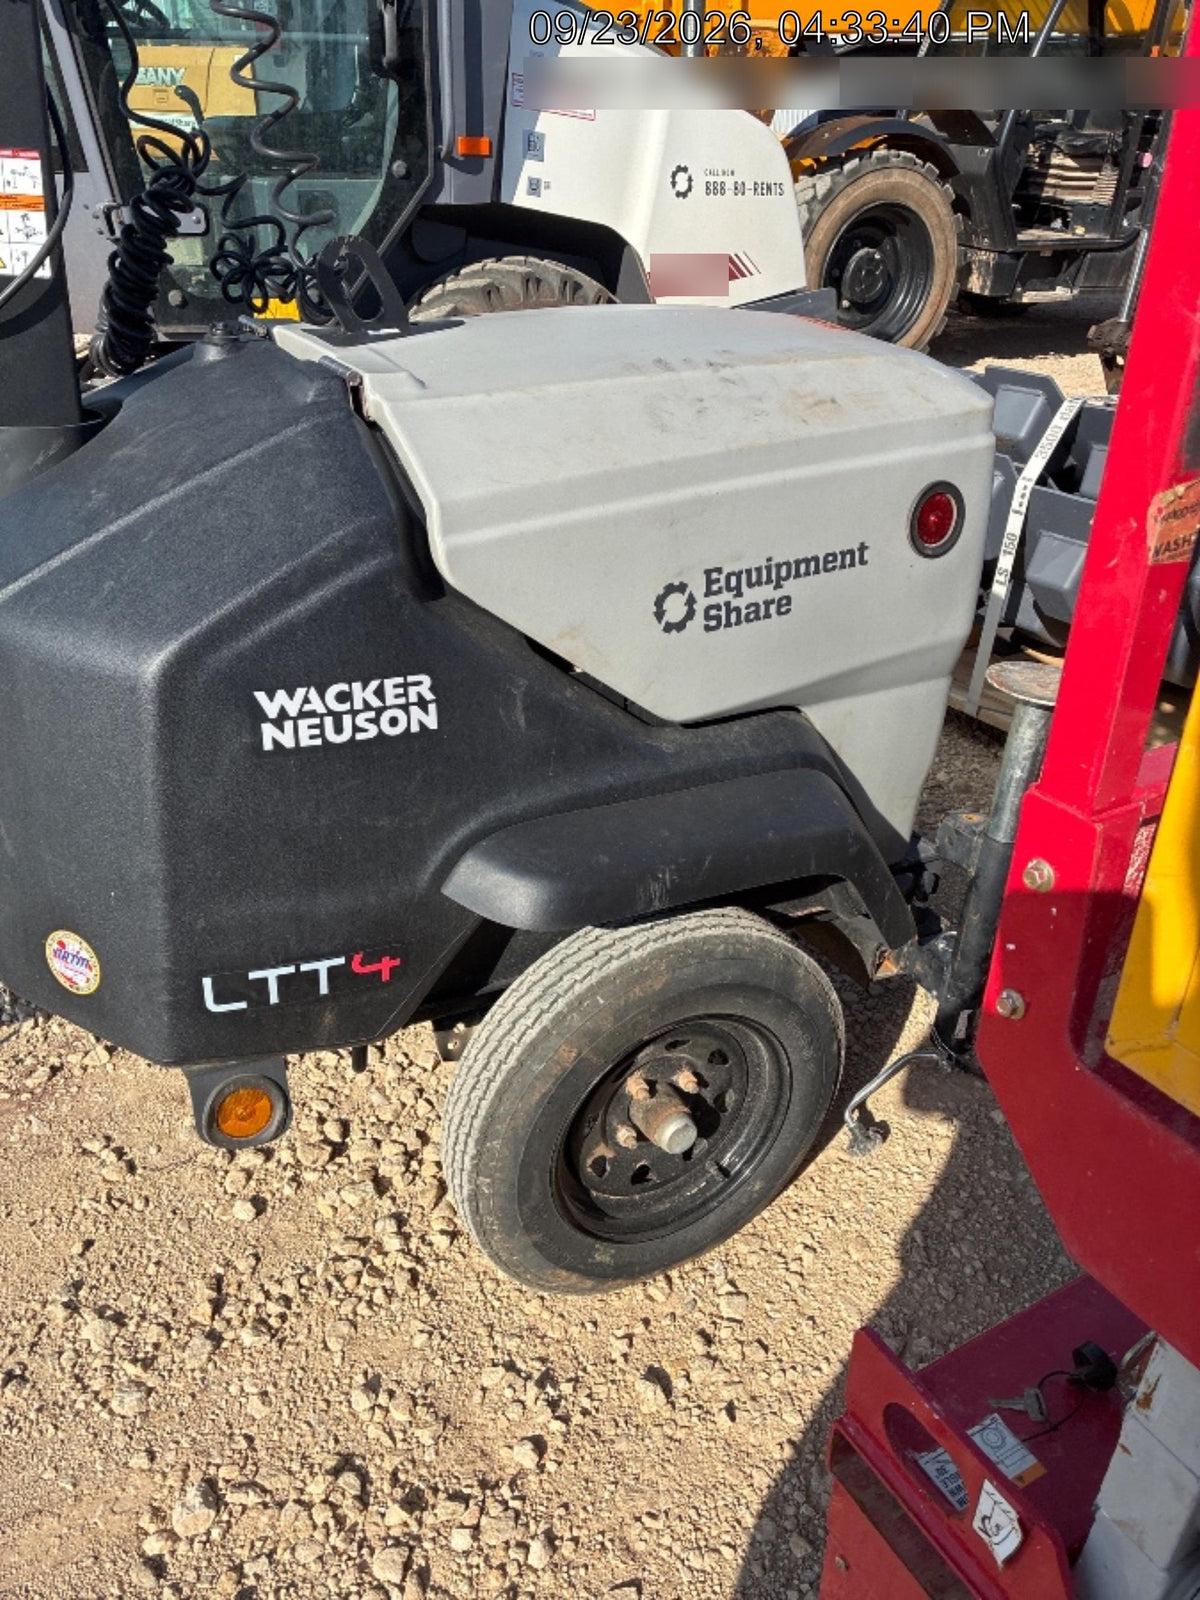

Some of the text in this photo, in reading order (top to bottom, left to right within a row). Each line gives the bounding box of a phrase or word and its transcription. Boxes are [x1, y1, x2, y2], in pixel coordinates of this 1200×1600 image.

[703, 541, 870, 599] Equipment
[703, 594, 792, 633] Share
[253, 673, 437, 719] WACKER
[261, 702, 438, 751] NEUSON
